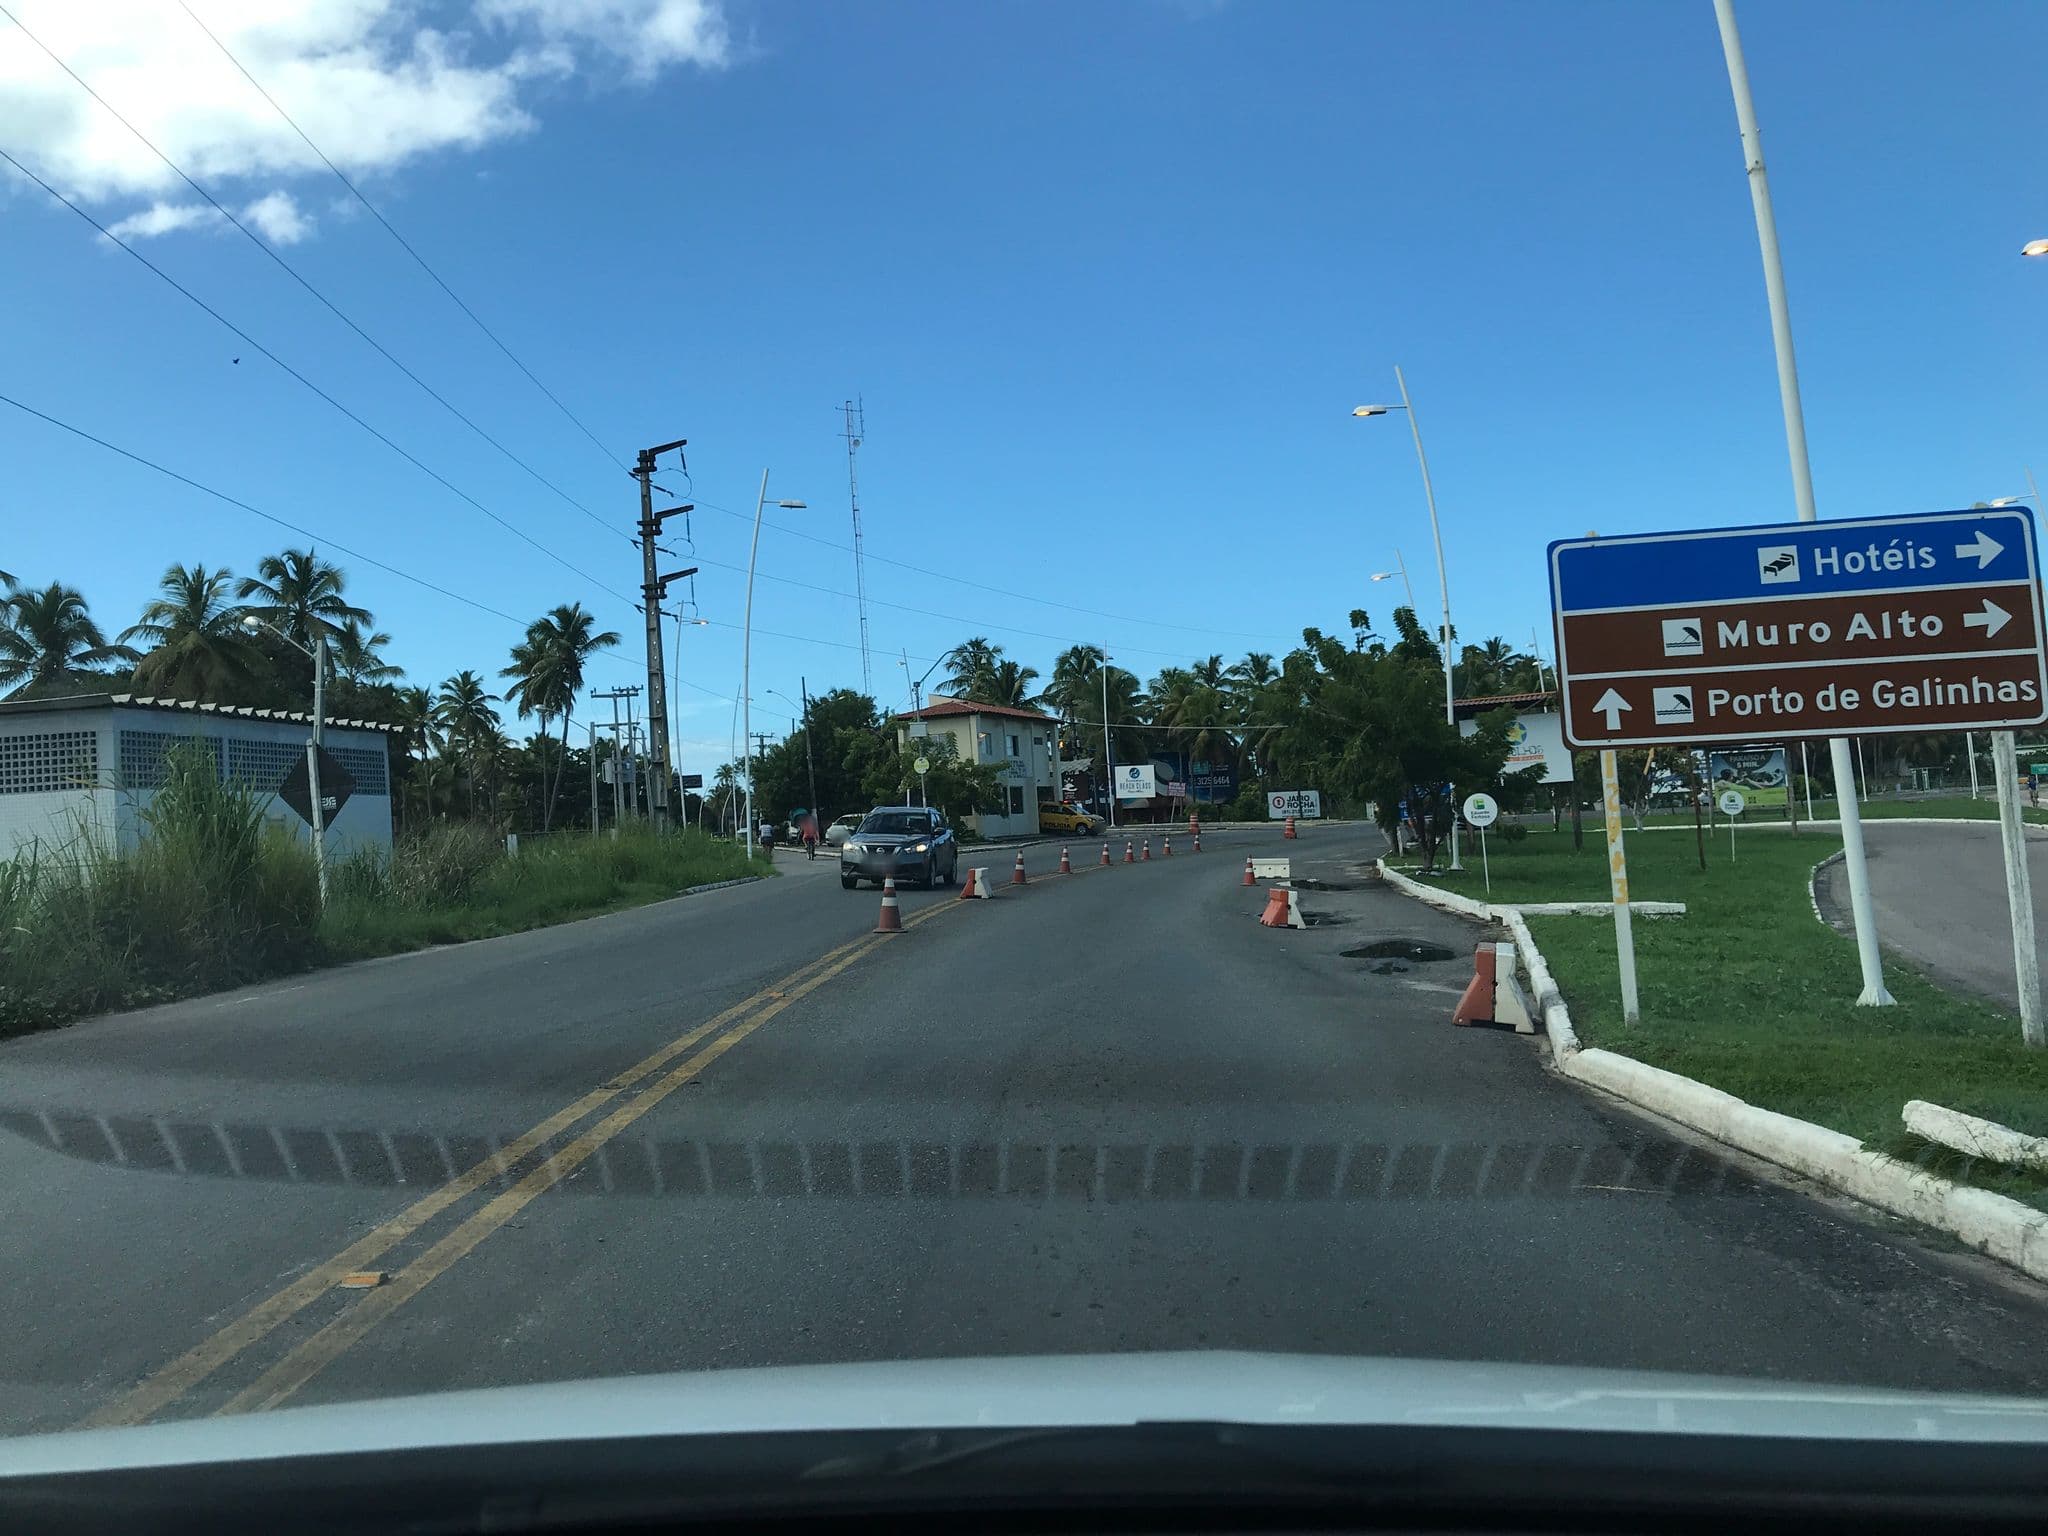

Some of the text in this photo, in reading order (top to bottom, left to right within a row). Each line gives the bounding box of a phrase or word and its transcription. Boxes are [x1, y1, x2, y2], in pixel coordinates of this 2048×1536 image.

[1814, 539, 1937, 576] Hotéis
[1717, 610, 1943, 649] Muro Alto
[1708, 675, 2038, 717] Porto de Galinhas
